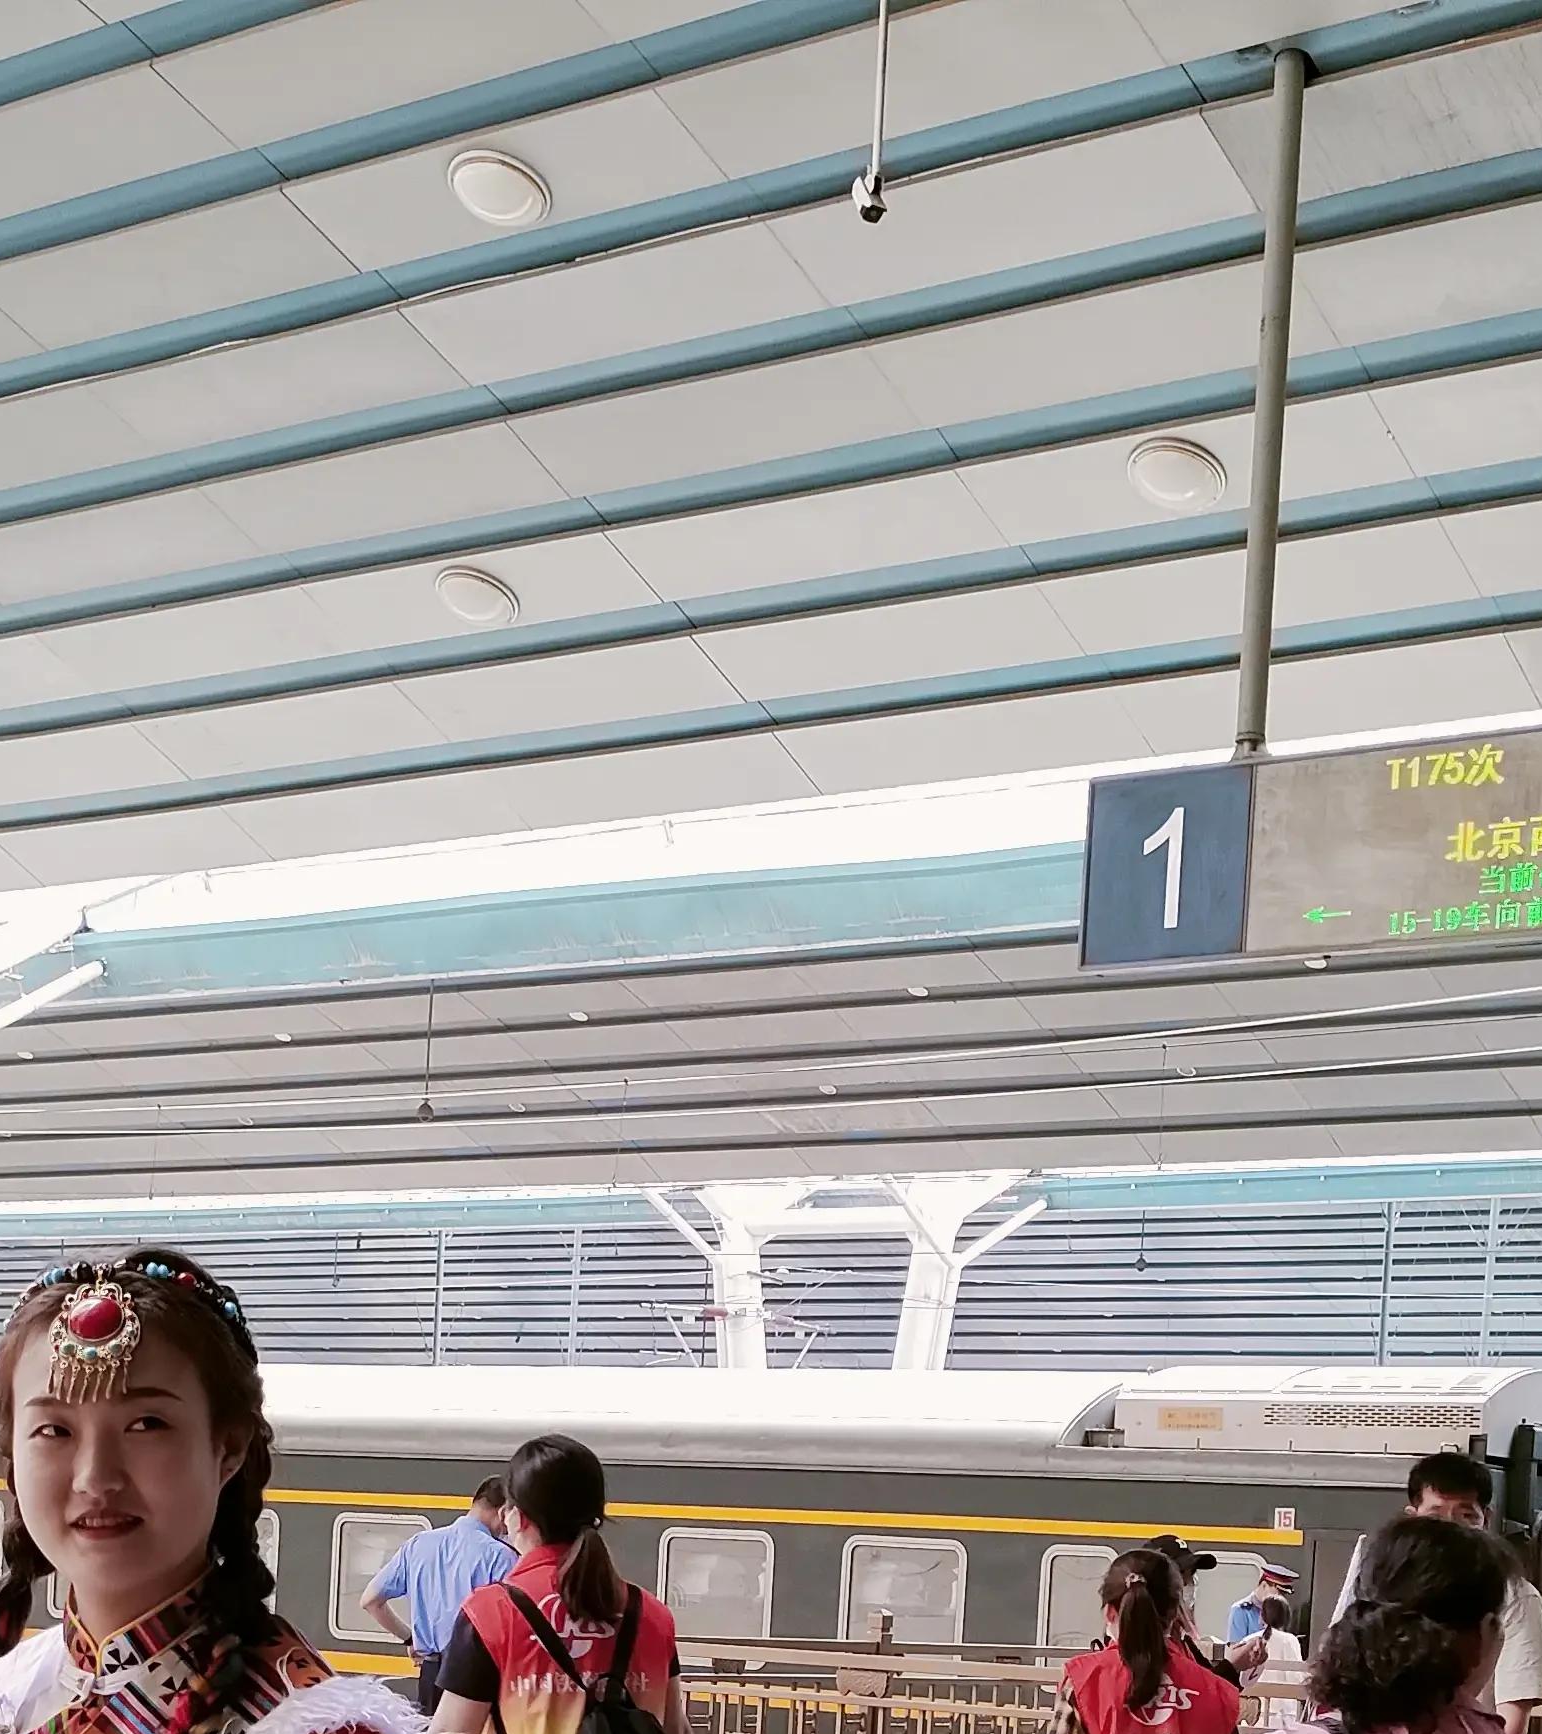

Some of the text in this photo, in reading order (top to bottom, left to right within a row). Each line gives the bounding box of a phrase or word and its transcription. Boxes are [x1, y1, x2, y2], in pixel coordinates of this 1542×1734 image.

[1386, 743, 1505, 790] T175次
[1142, 806, 1186, 931] 1
[1276, 1510, 1293, 1528] 15
